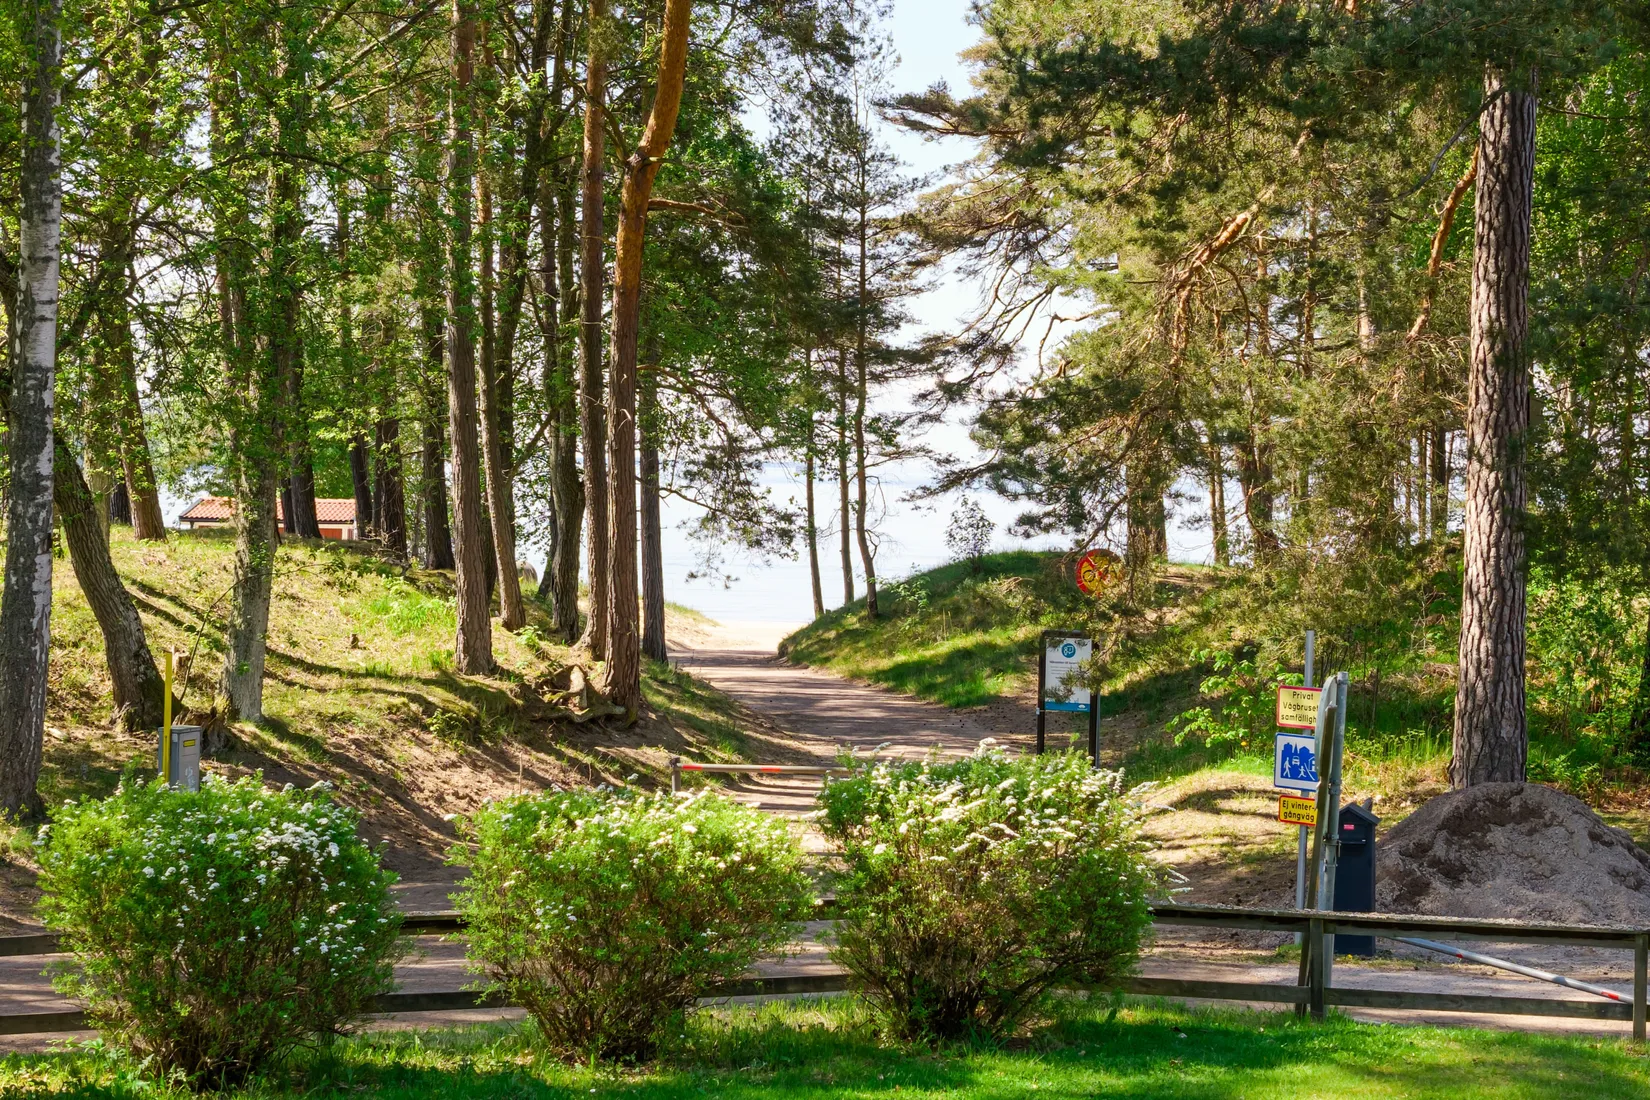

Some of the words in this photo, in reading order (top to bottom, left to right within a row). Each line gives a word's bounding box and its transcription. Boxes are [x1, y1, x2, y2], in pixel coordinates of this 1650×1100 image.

[1293, 691, 1314, 700] Privat
[1281, 714, 1317, 724] samfälligh
[1282, 800, 1289, 809] Ej
[1291, 801, 1315, 811] vinter-
[1283, 811, 1315, 822] gångväg
